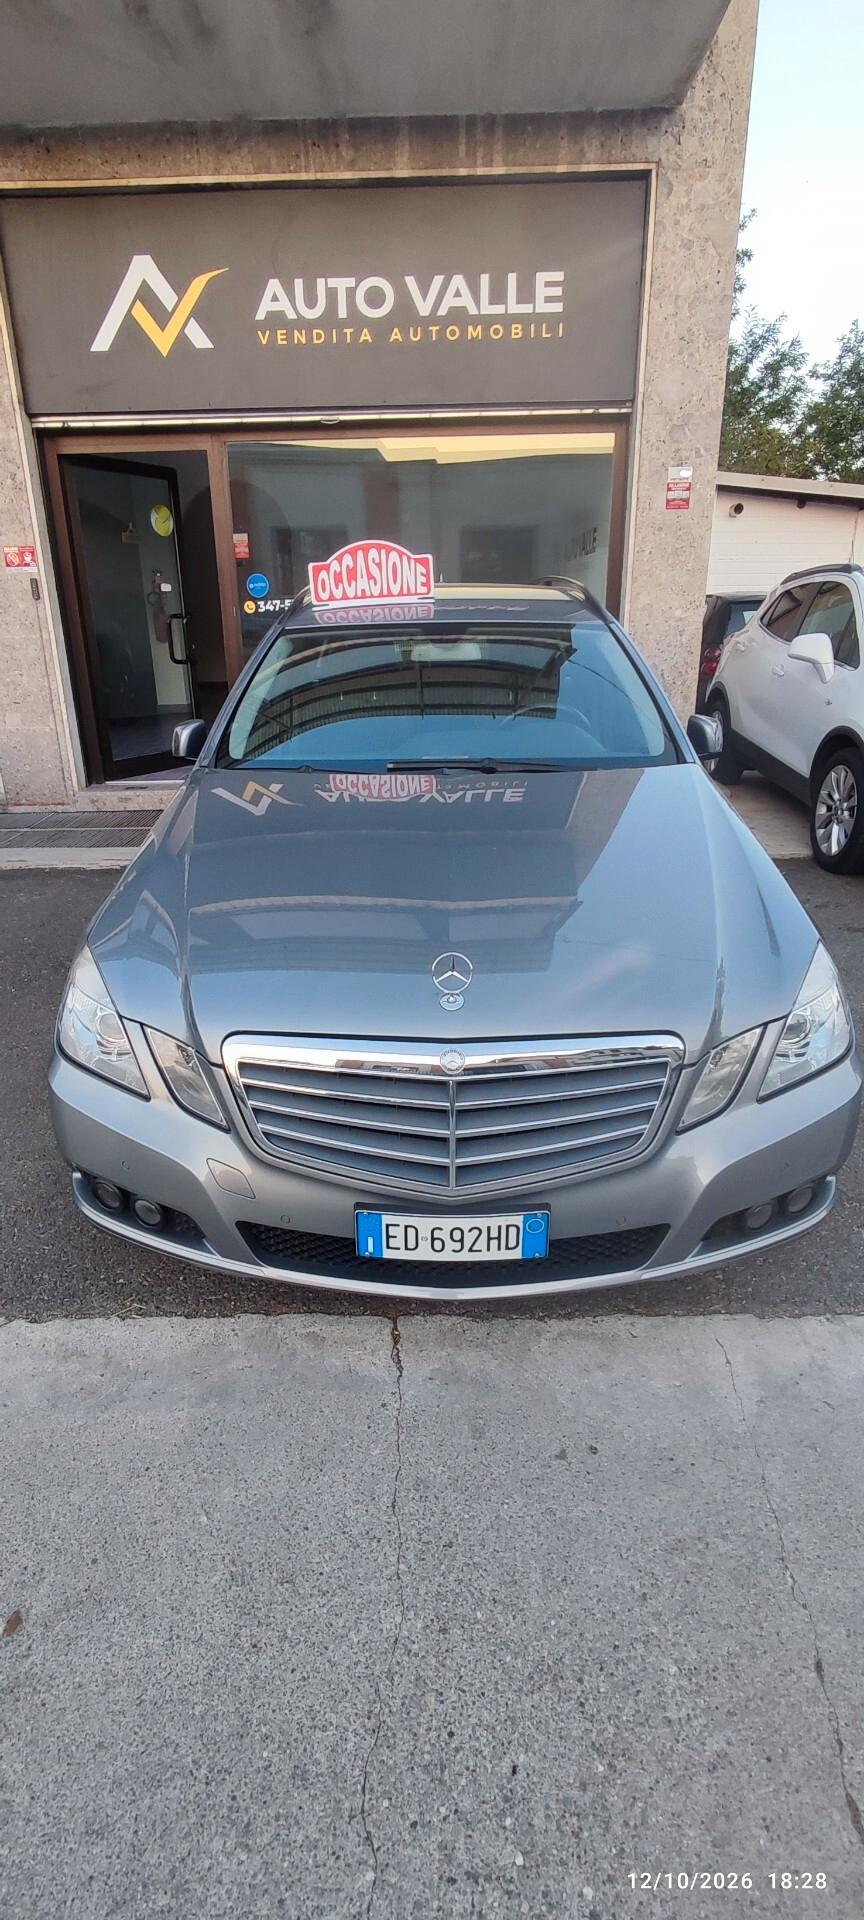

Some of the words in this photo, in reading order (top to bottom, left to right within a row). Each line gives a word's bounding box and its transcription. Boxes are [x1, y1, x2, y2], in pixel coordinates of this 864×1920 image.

[254, 276, 395, 321] AUTO
[404, 271, 566, 317] VALLE
[256, 328, 373, 345] VENDITA
[389, 323, 564, 343] AUTOMOBILI
[317, 547, 428, 600] OCCASIONE
